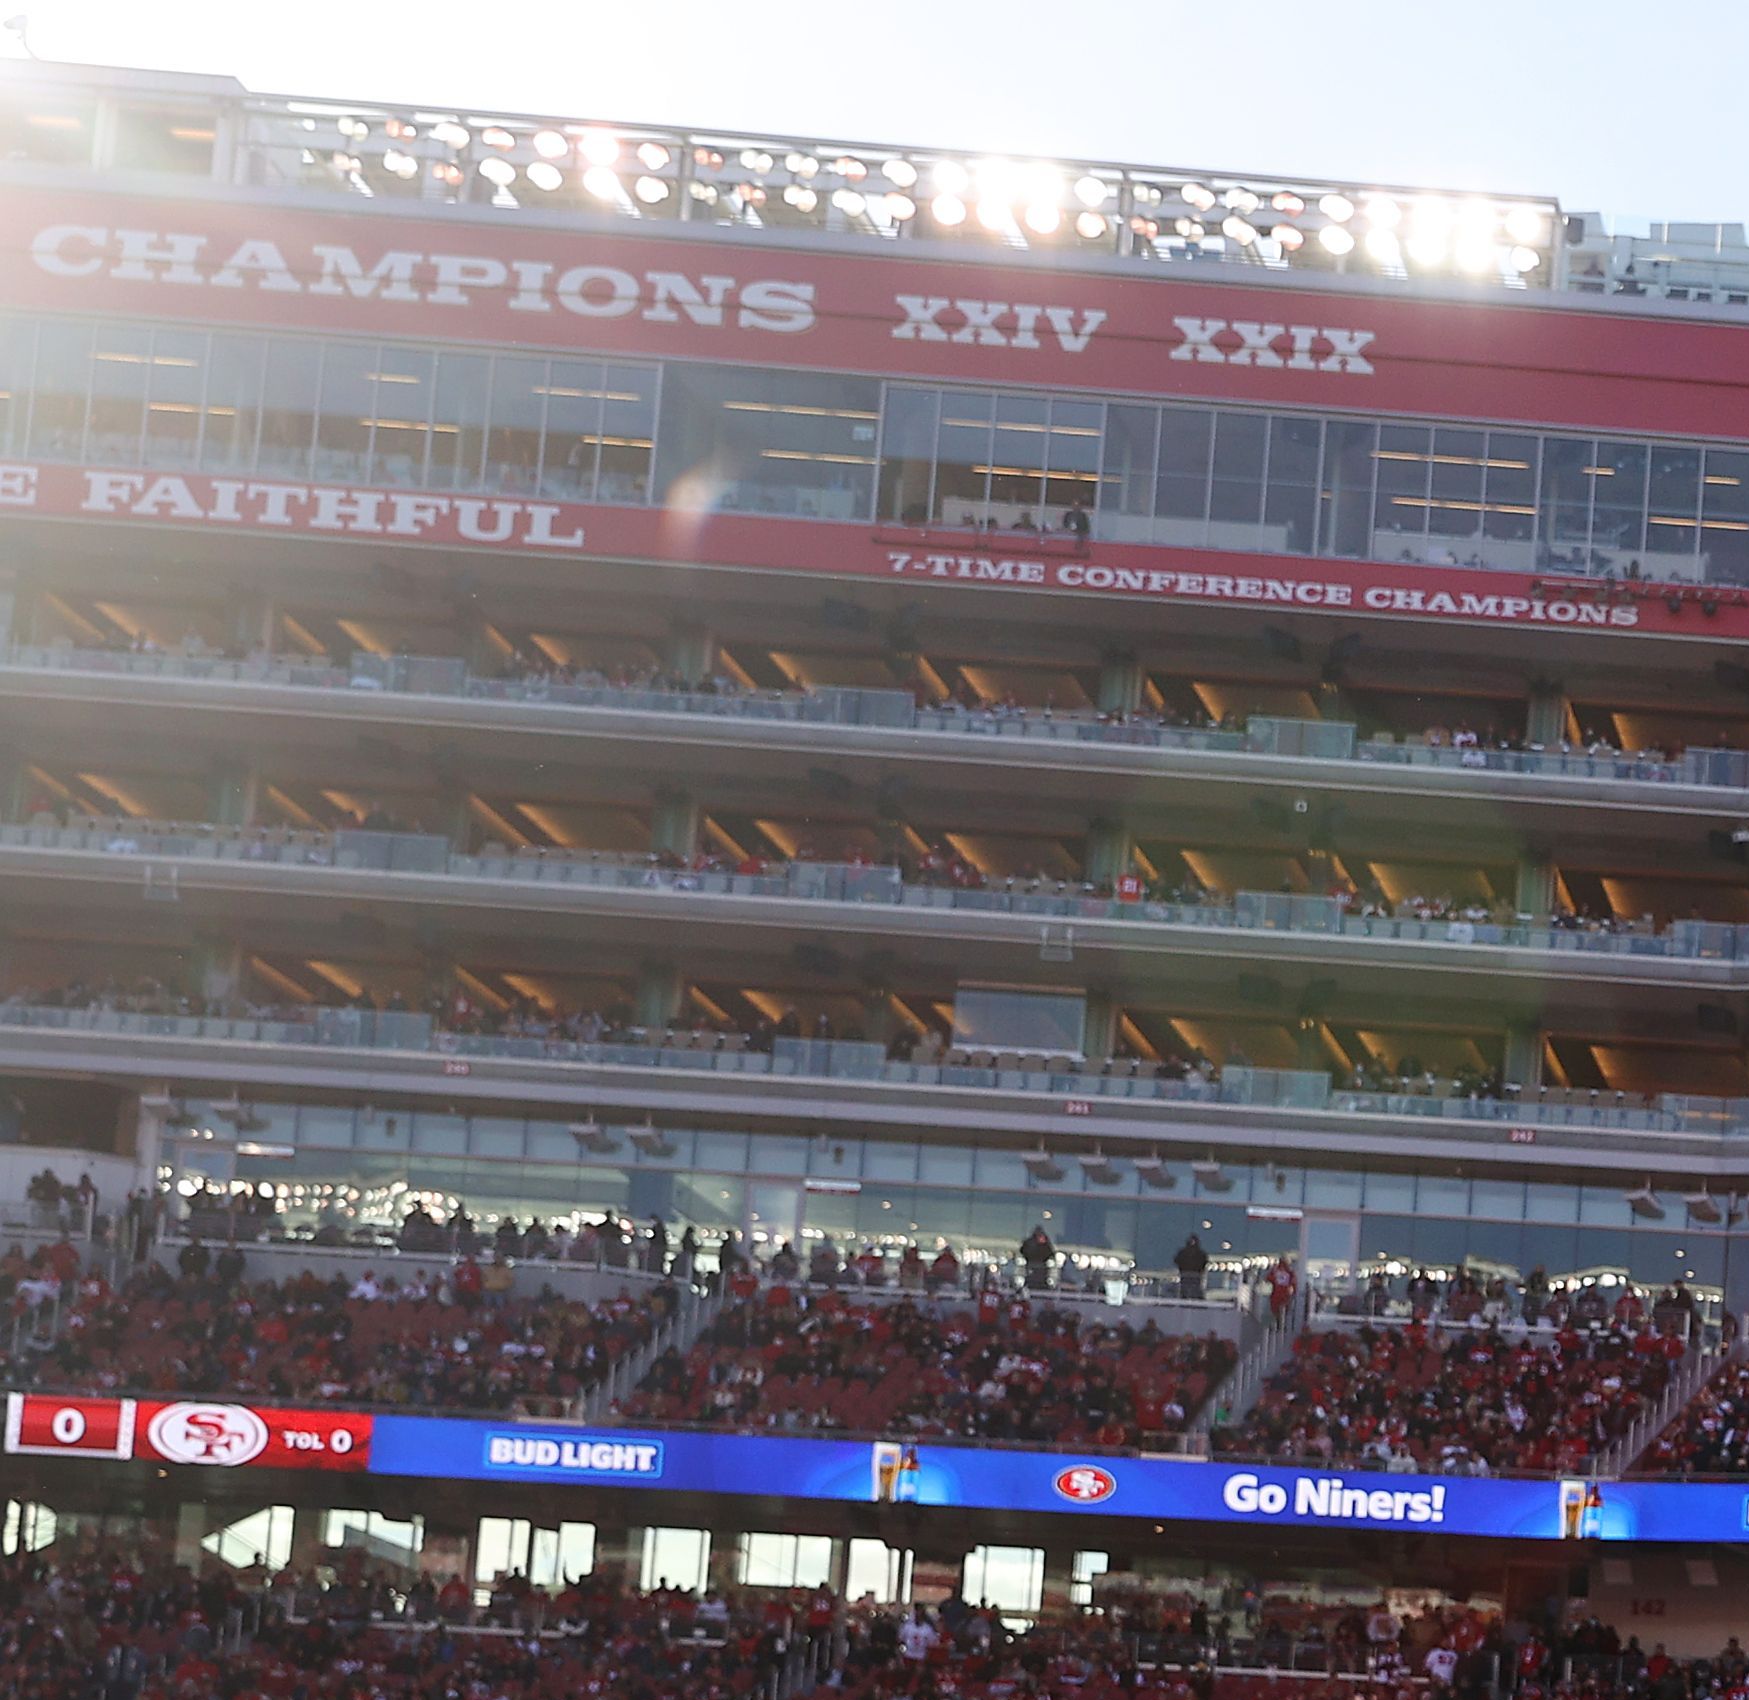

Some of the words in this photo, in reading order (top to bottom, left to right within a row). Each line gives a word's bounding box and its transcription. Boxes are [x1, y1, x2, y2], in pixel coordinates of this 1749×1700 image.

[31, 225, 817, 334] CHAMPIONS
[891, 294, 1107, 353] XXIV
[1170, 315, 1376, 375] XXIX
[81, 471, 585, 548] FAITHFUL
[887, 552, 1045, 584] 7-TIME
[1056, 564, 1352, 607] CONFERENCE
[1363, 587, 1639, 628] CHAMPIONS
[53, 1409, 84, 1444] 0
[283, 1431, 324, 1452] TOL
[329, 1430, 352, 1453] 0
[490, 1438, 560, 1466] BUD
[561, 1441, 656, 1472] LIGHT
[1223, 1474, 1287, 1514] Go
[1296, 1477, 1445, 1522] Niners!
